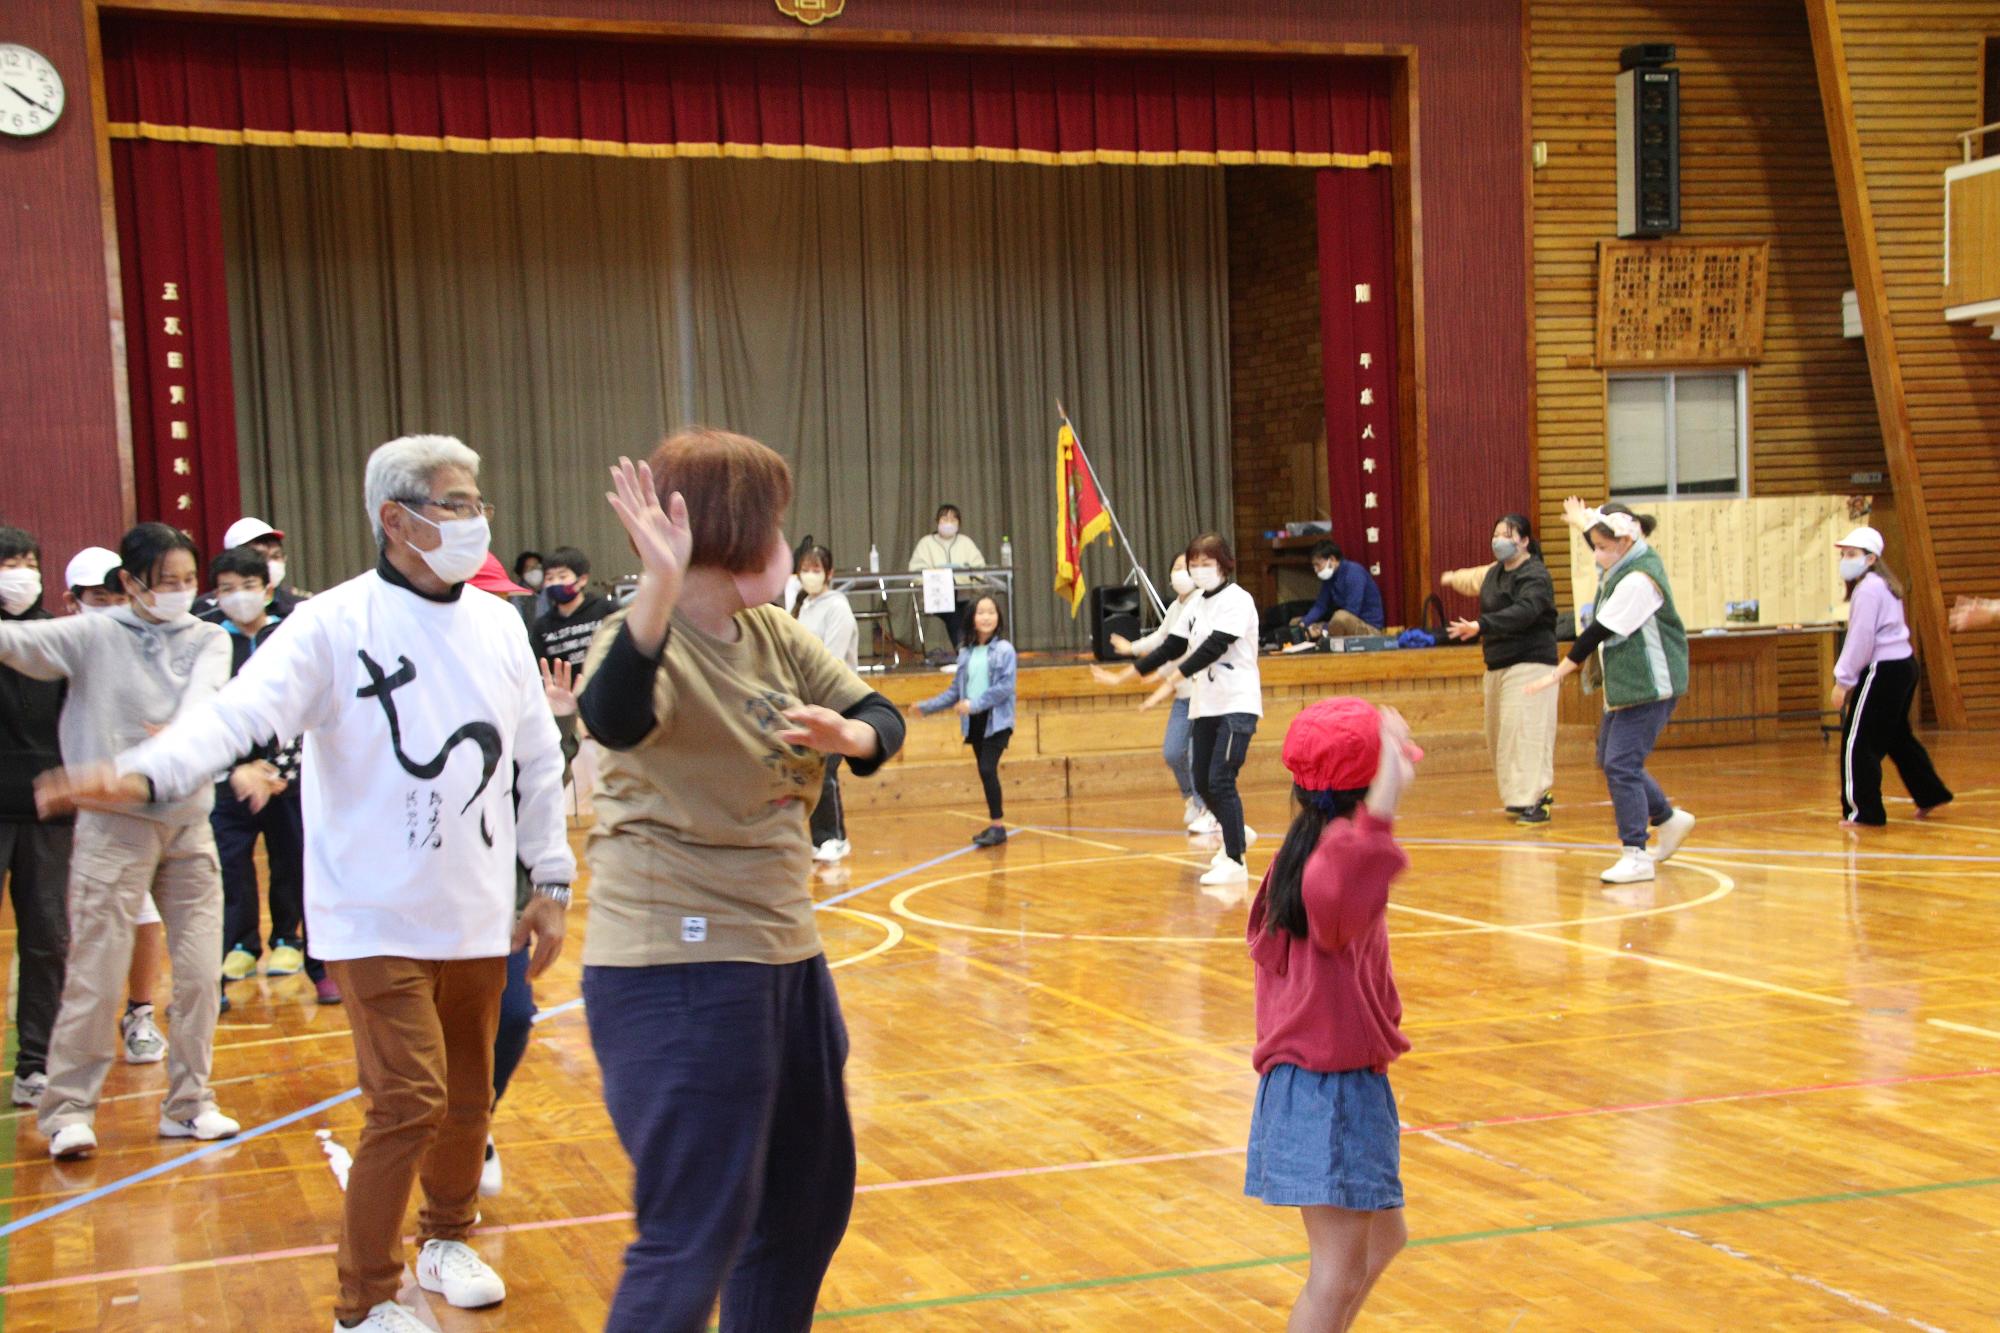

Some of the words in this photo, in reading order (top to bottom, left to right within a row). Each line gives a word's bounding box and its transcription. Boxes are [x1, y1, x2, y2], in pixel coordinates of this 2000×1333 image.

[43, 84, 54, 98] 3
[12, 112, 23, 128] 6
[29, 110, 40, 125] 5
